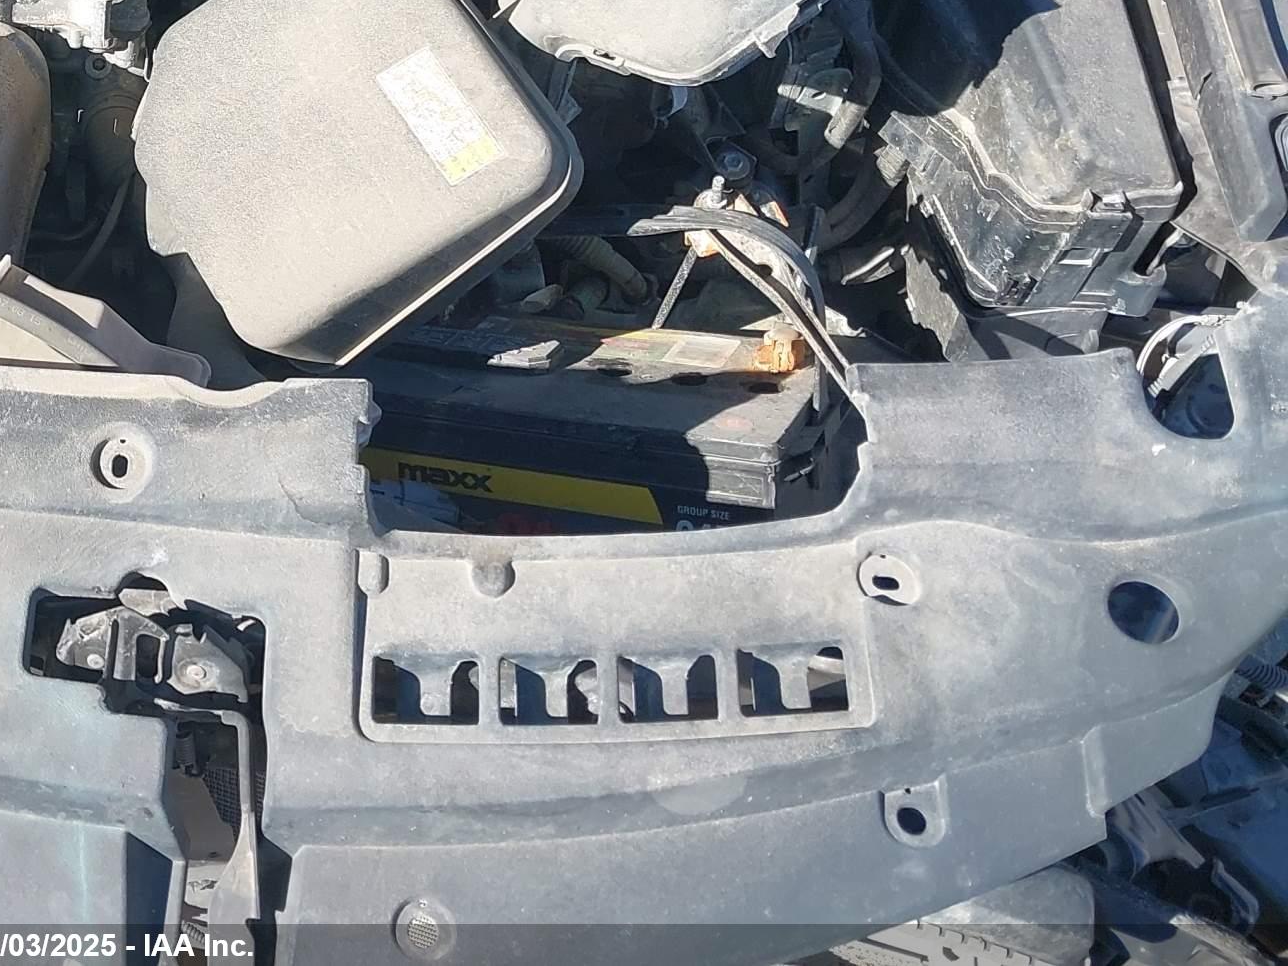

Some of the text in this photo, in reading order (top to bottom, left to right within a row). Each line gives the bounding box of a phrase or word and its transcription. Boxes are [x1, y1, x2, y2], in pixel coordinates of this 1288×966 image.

[398, 462, 494, 494] maxx
[677, 505, 730, 521] GROUP SIZE
